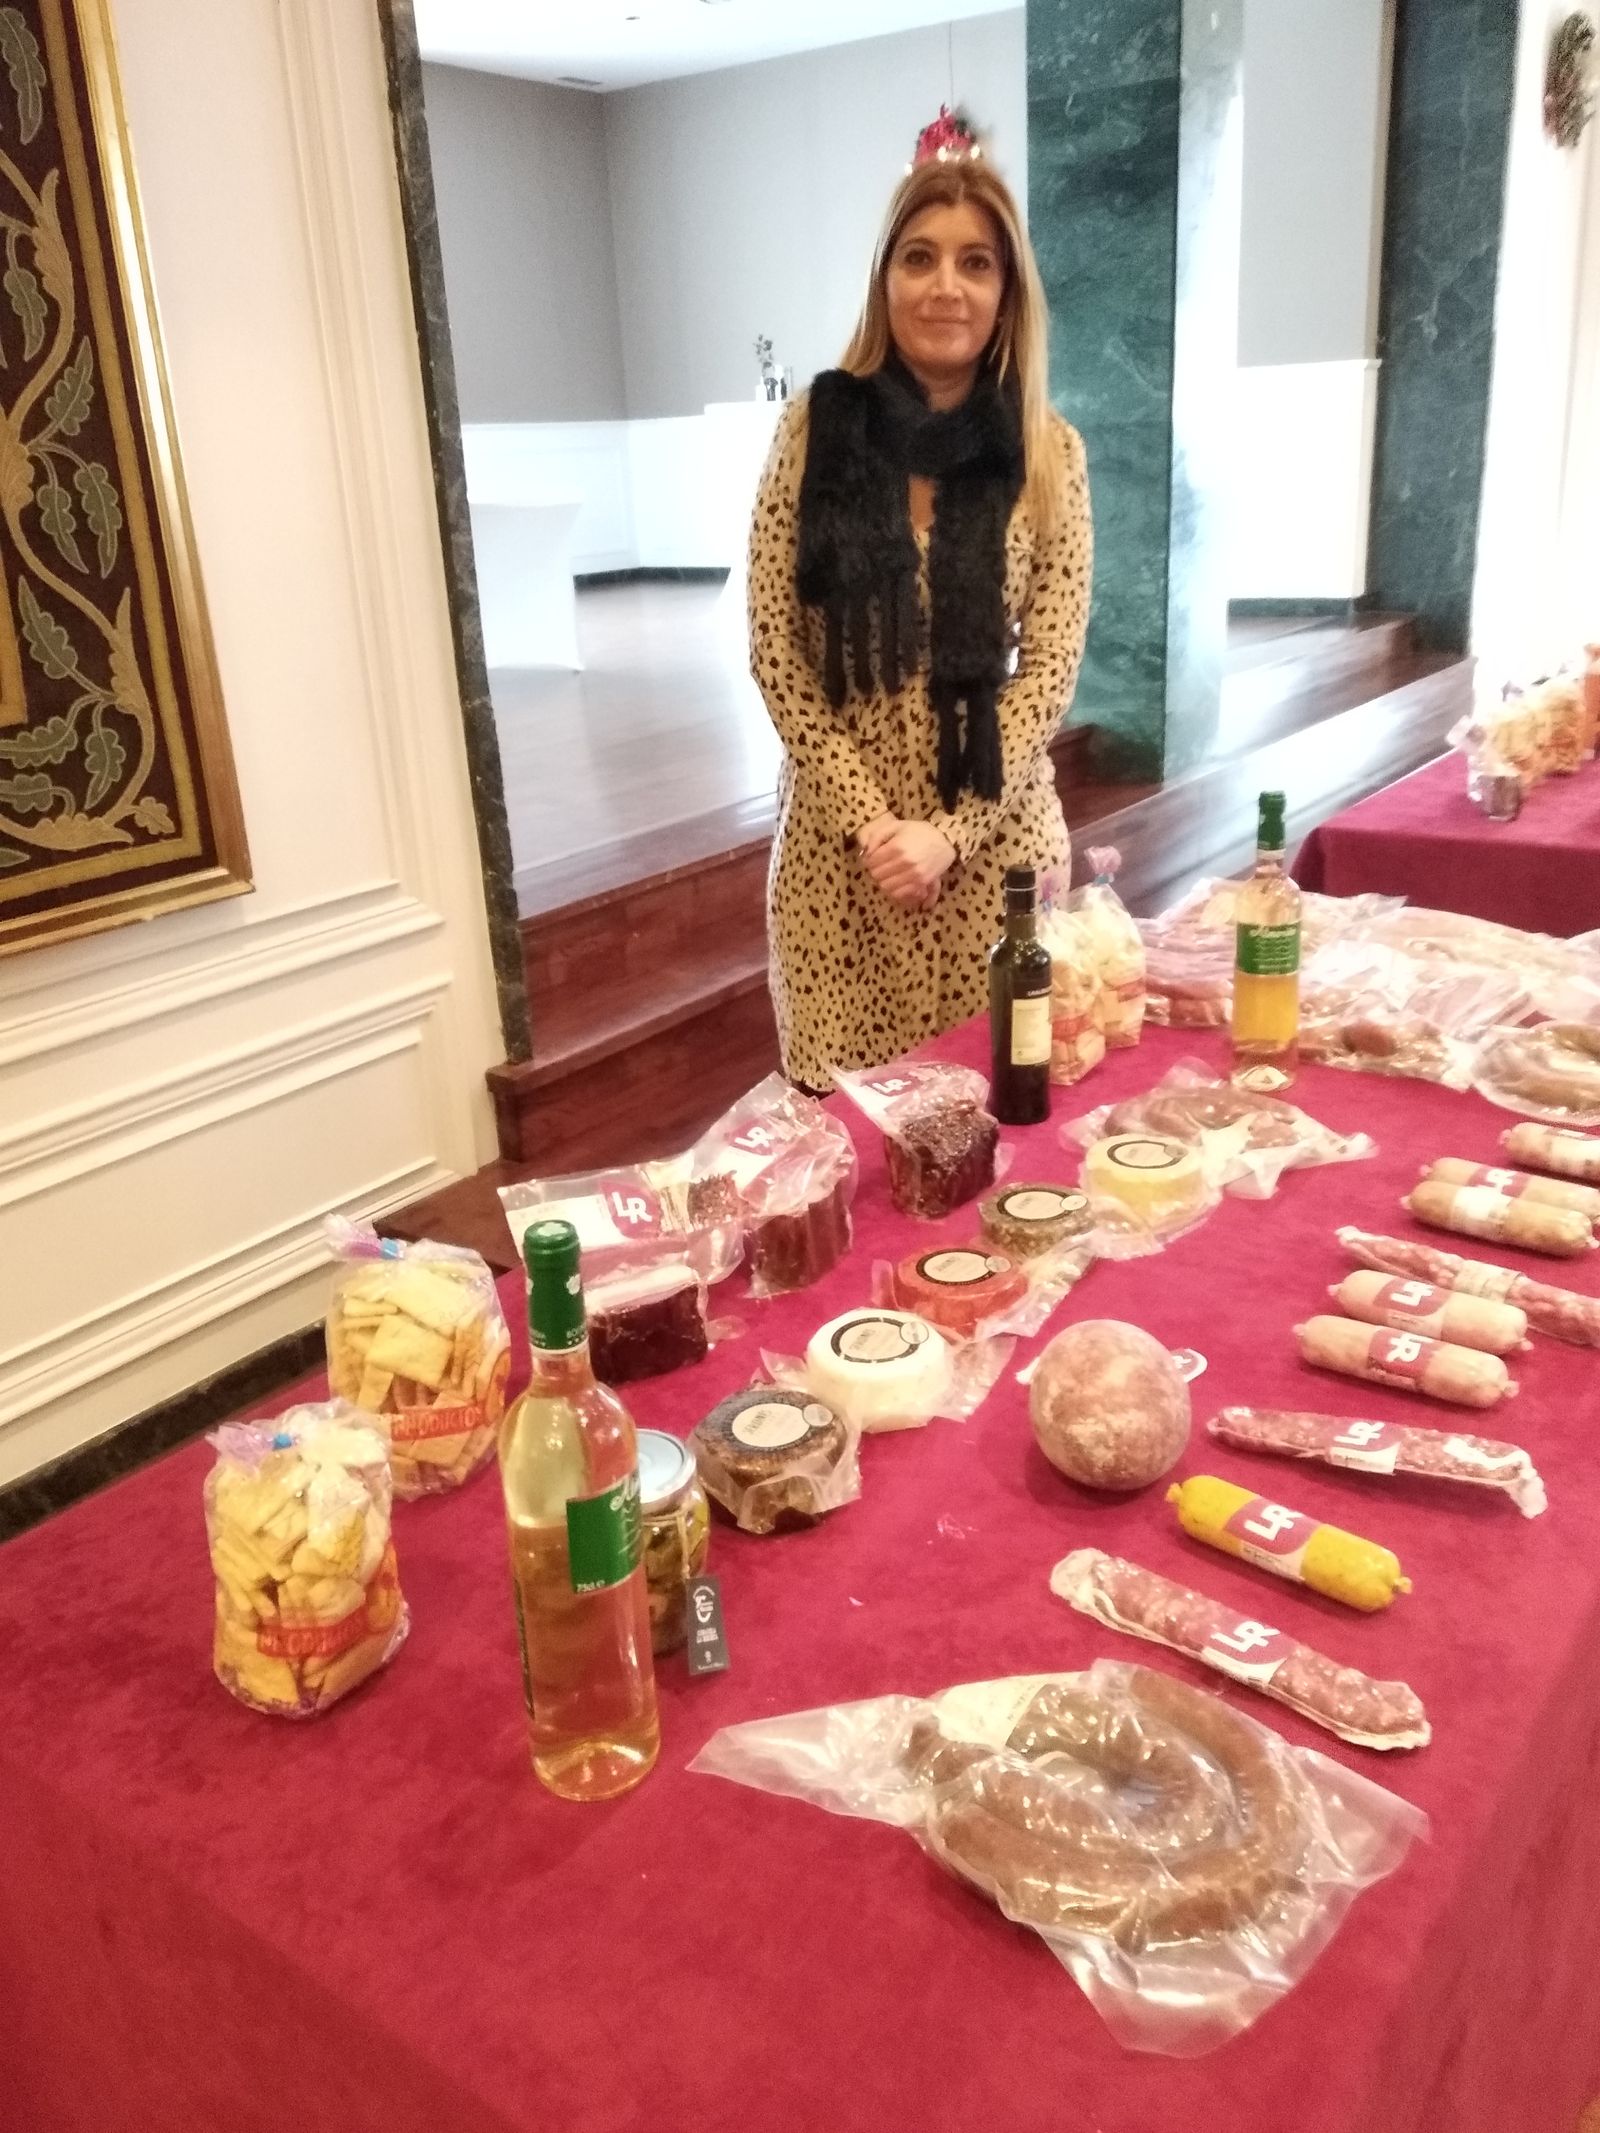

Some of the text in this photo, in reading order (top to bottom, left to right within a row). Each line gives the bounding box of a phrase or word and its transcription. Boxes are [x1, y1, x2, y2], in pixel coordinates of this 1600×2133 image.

[734, 1126, 774, 1148] LR
[611, 1191, 652, 1224] LR
[1333, 1422, 1385, 1445] LR
[1243, 1505, 1303, 1541] LR
[1209, 1621, 1280, 1652] LR
